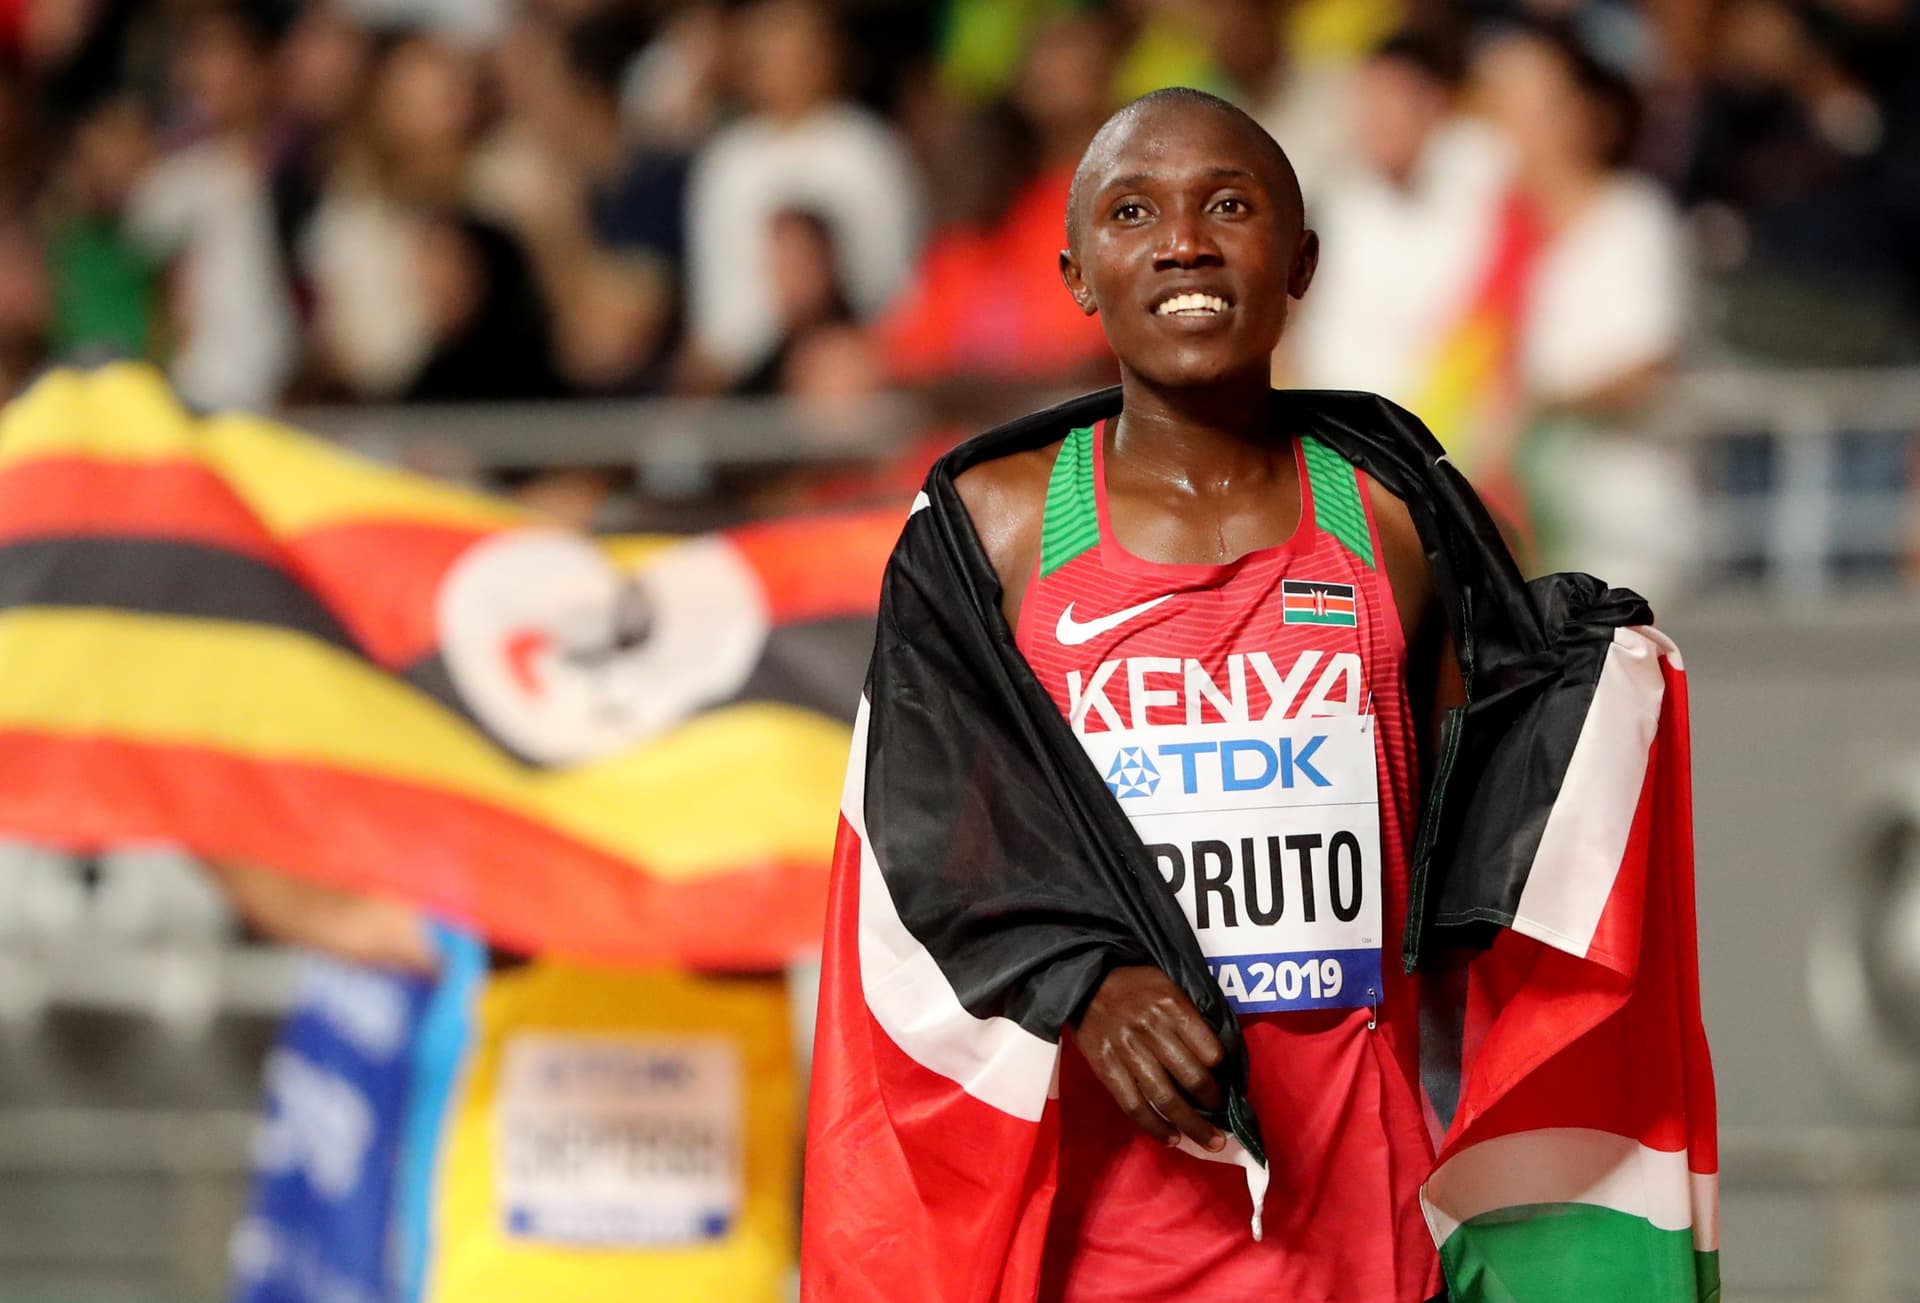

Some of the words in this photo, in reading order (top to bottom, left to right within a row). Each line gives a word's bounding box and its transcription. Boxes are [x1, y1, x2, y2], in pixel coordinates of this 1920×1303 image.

[1066, 650, 1361, 734] KENYA
[1158, 735, 1333, 794] TDK
[1142, 831, 1363, 930] PRUTO
[1207, 957, 1343, 1003] A2019
